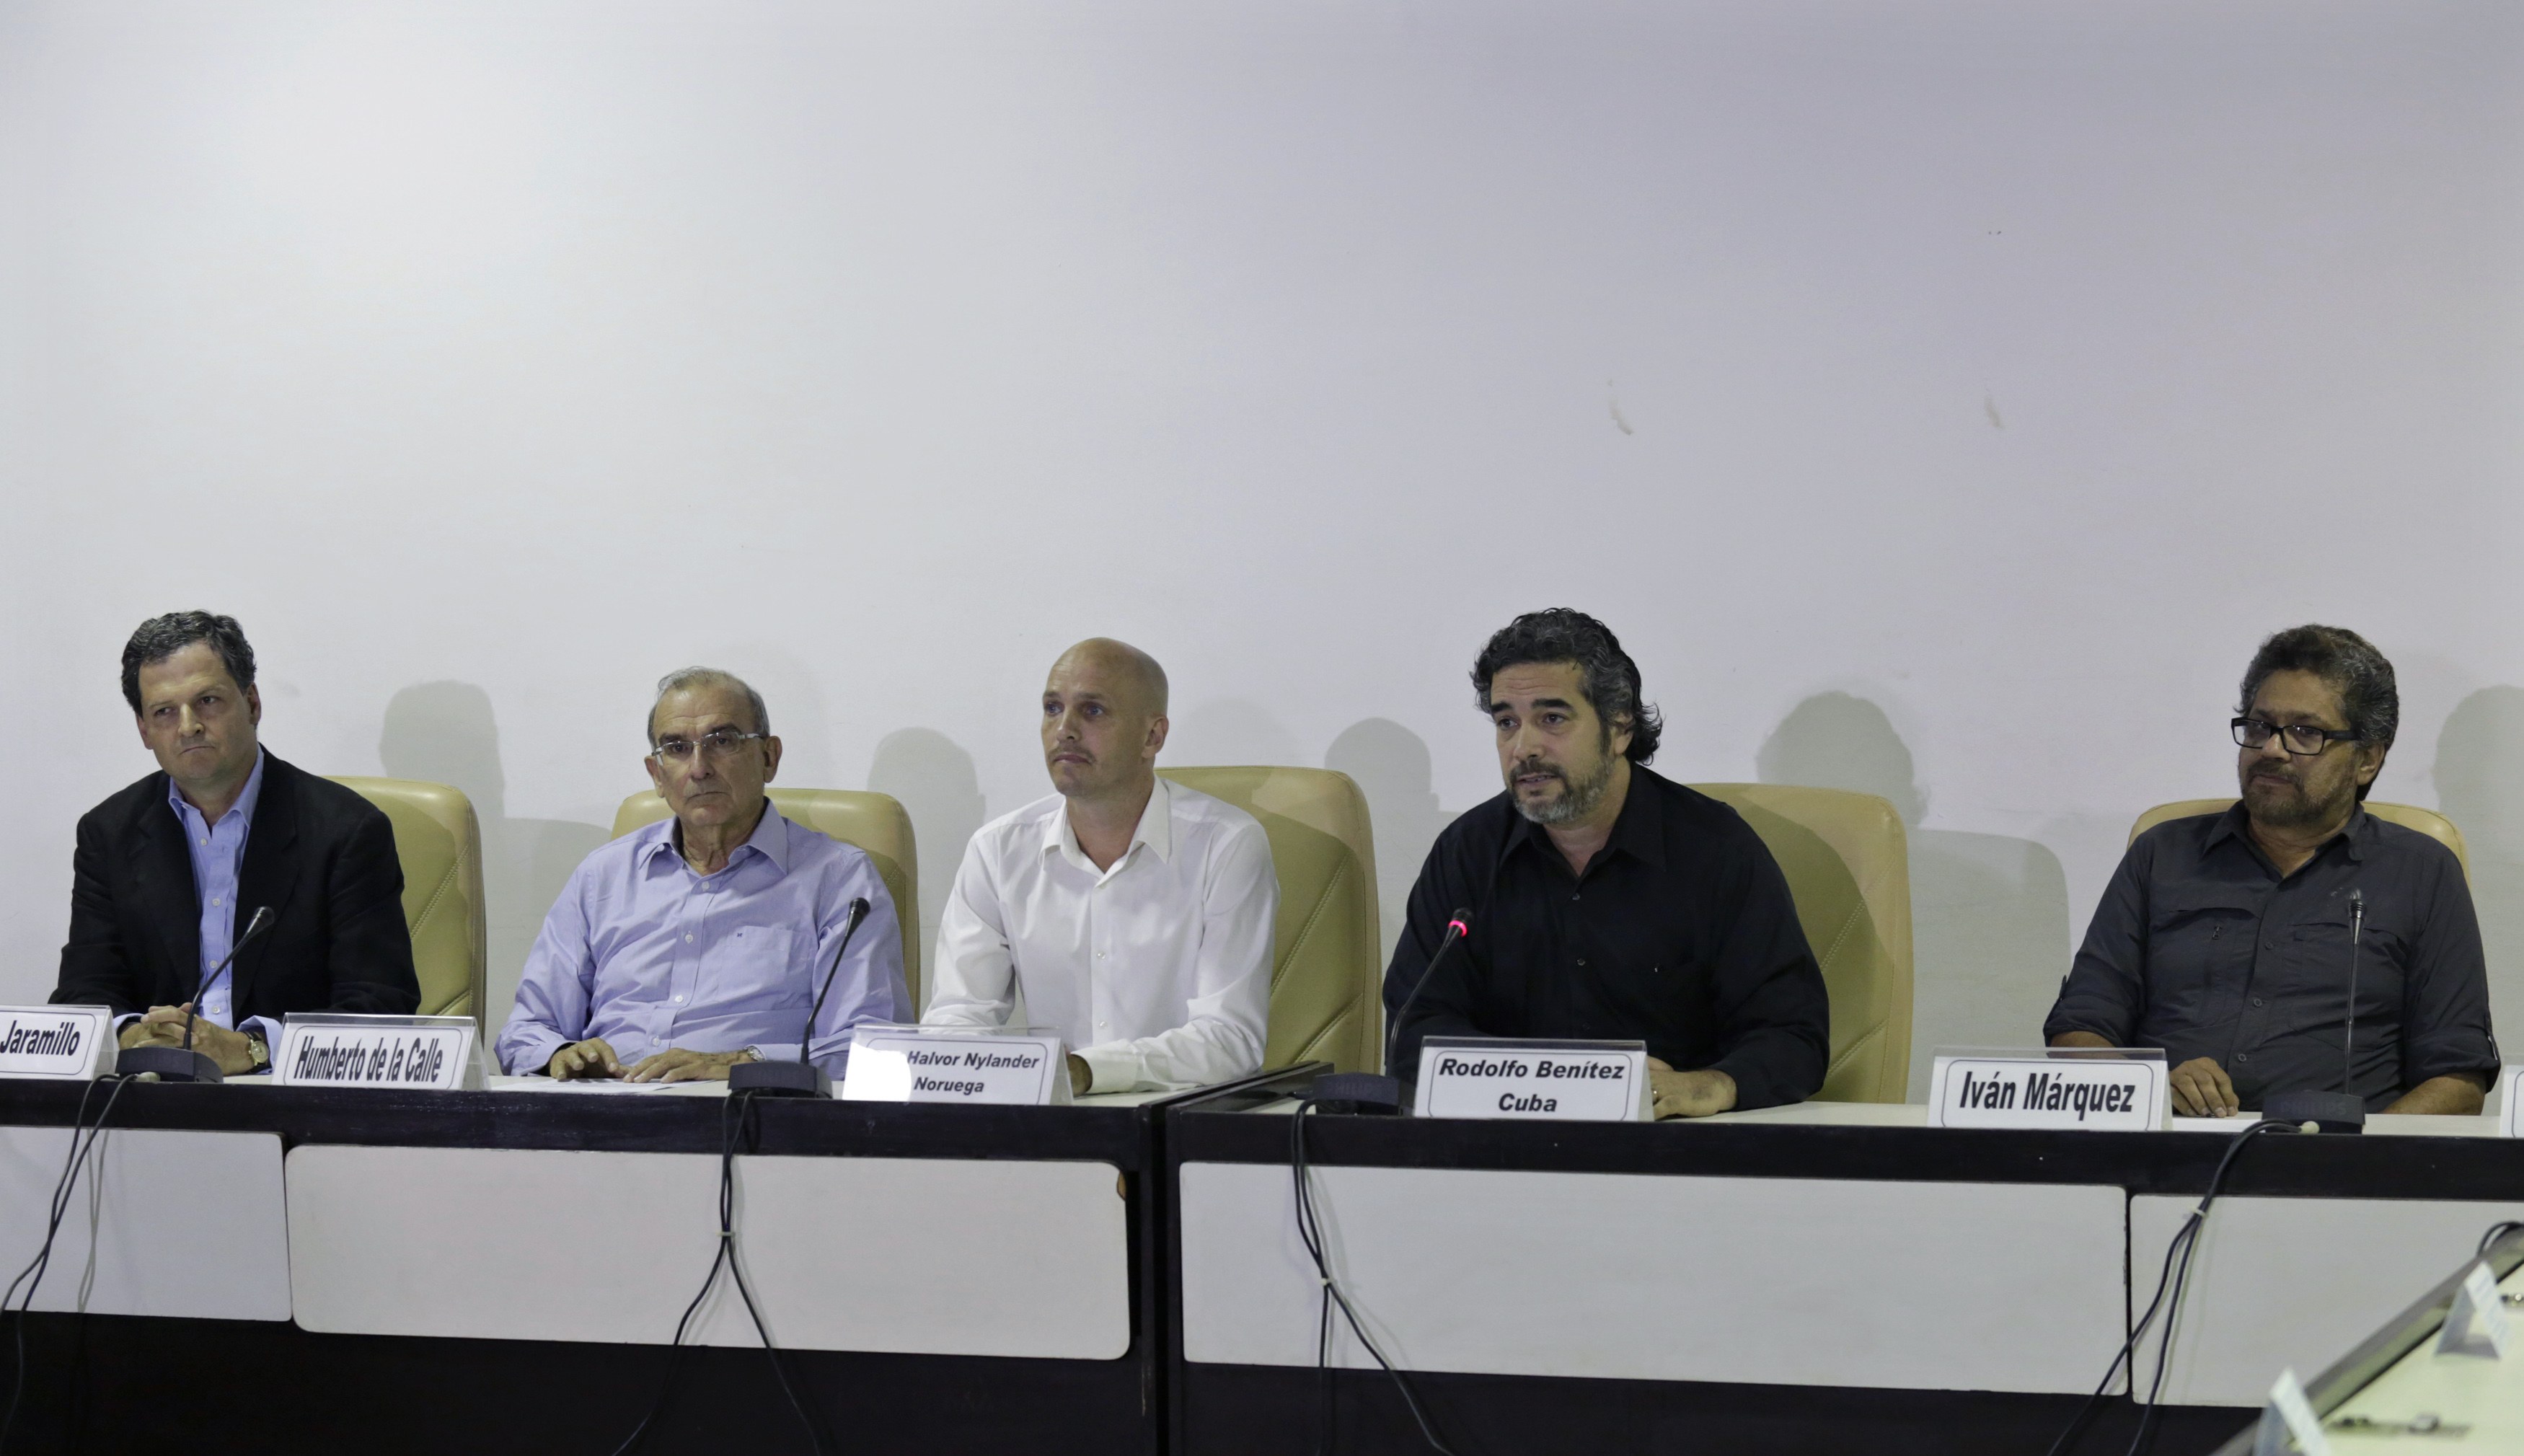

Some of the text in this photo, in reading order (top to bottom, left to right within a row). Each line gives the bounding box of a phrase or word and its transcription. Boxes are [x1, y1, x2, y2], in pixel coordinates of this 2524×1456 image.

[0, 1020, 81, 1056] Jaramillo
[294, 1036, 443, 1082] Humberto de la Calle
[907, 1050, 1040, 1070] Halvor Nylander
[1439, 1058, 1625, 1080] Rodolfo Benítez
[914, 1077, 984, 1095] Noruega
[1959, 1071, 2135, 1121] Iván Márquez
[1498, 1093, 1558, 1113] Cuba
